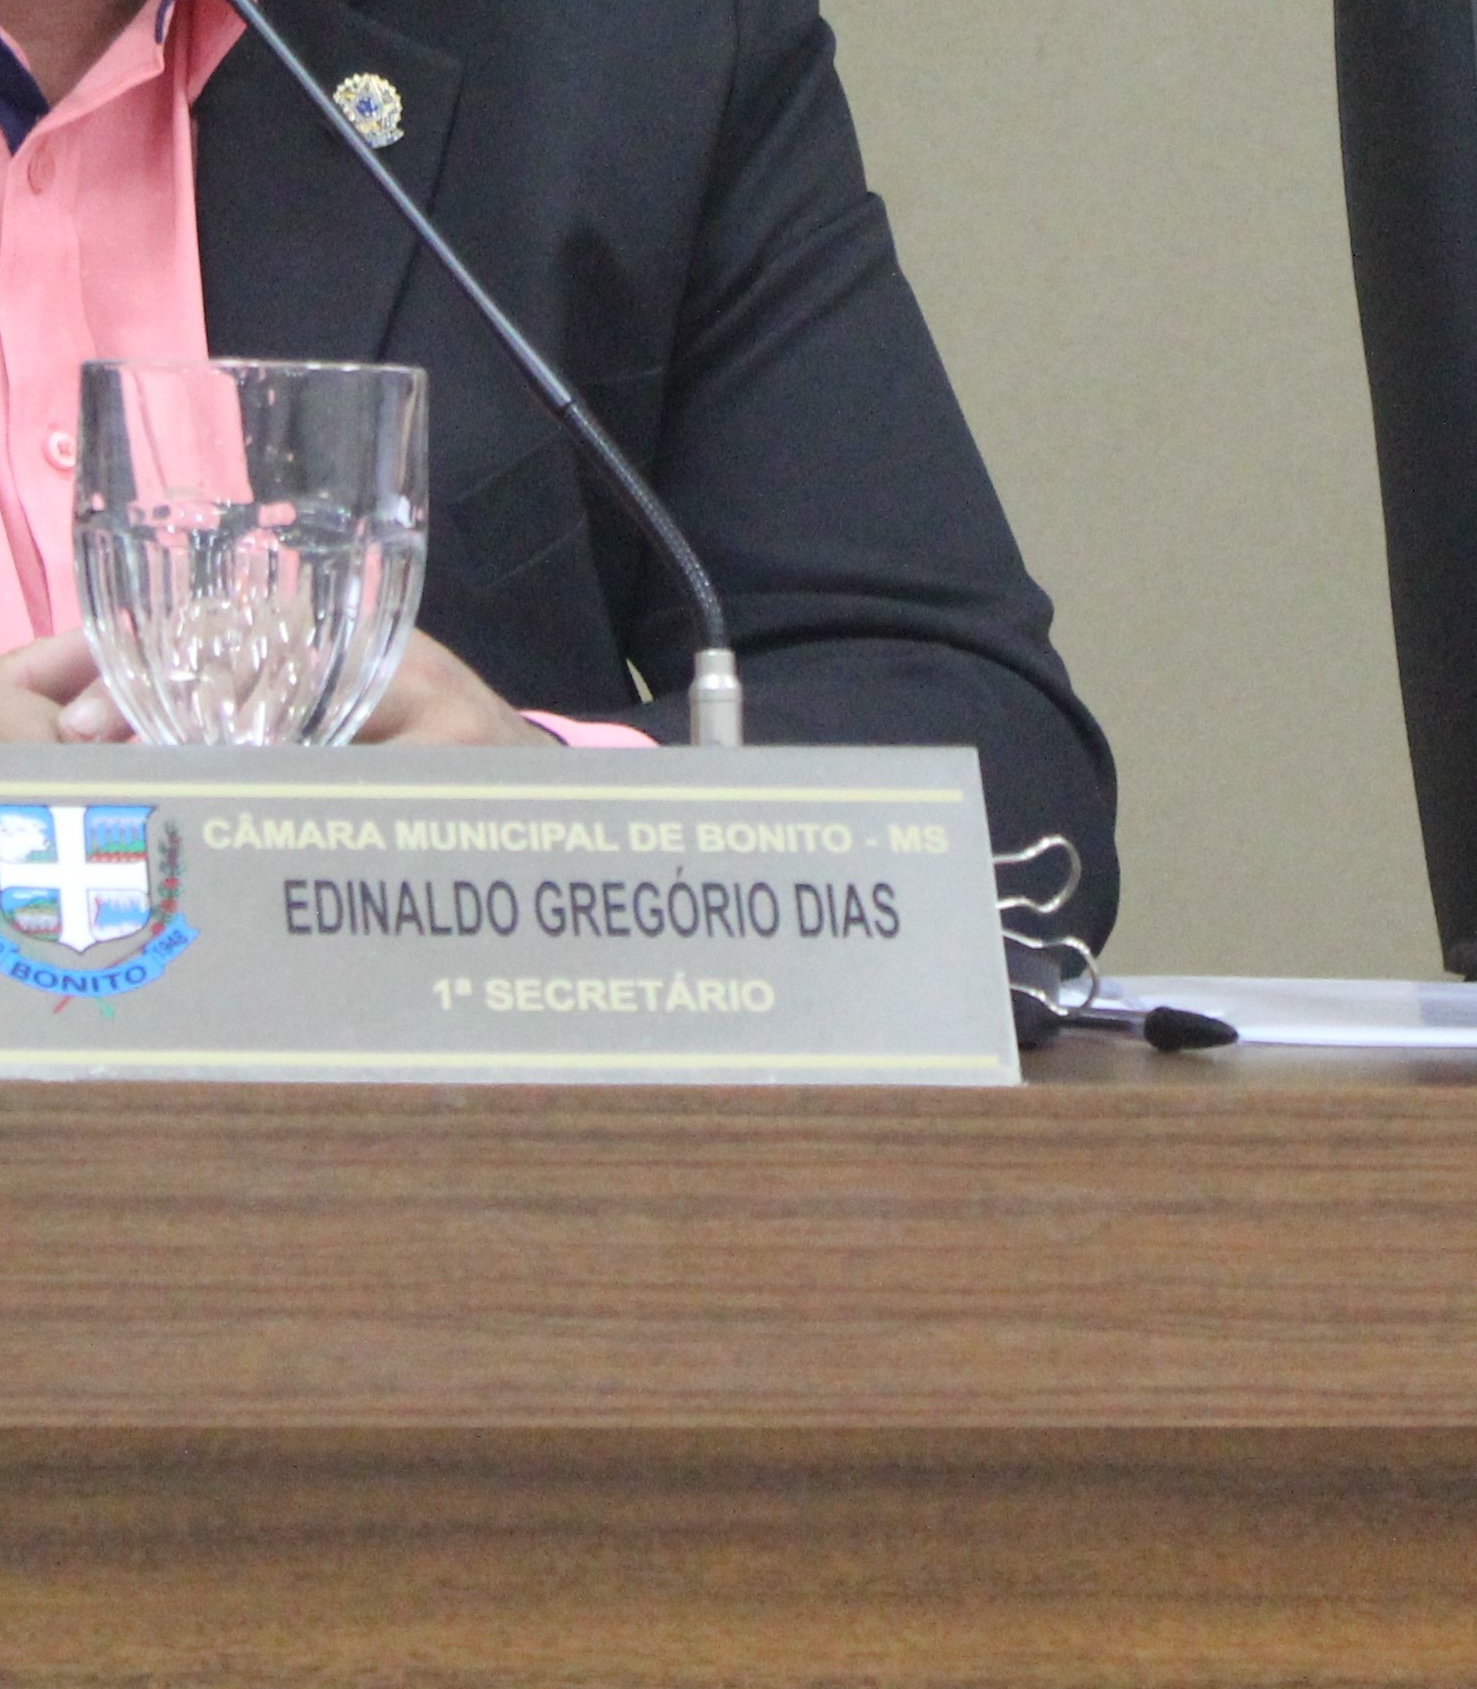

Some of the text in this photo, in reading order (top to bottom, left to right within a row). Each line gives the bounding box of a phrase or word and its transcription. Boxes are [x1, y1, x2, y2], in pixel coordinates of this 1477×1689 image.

[202, 812, 386, 851] CÂMARA
[395, 819, 620, 852] MUNICIPAL
[629, 822, 686, 853] DE
[696, 823, 854, 854] BONITO
[888, 824, 951, 854] MS
[284, 865, 902, 939] EDINALDO GREGÓRIO DIAS
[10, 961, 148, 994] BONITO
[484, 970, 777, 1013] SECRETÁRIO
